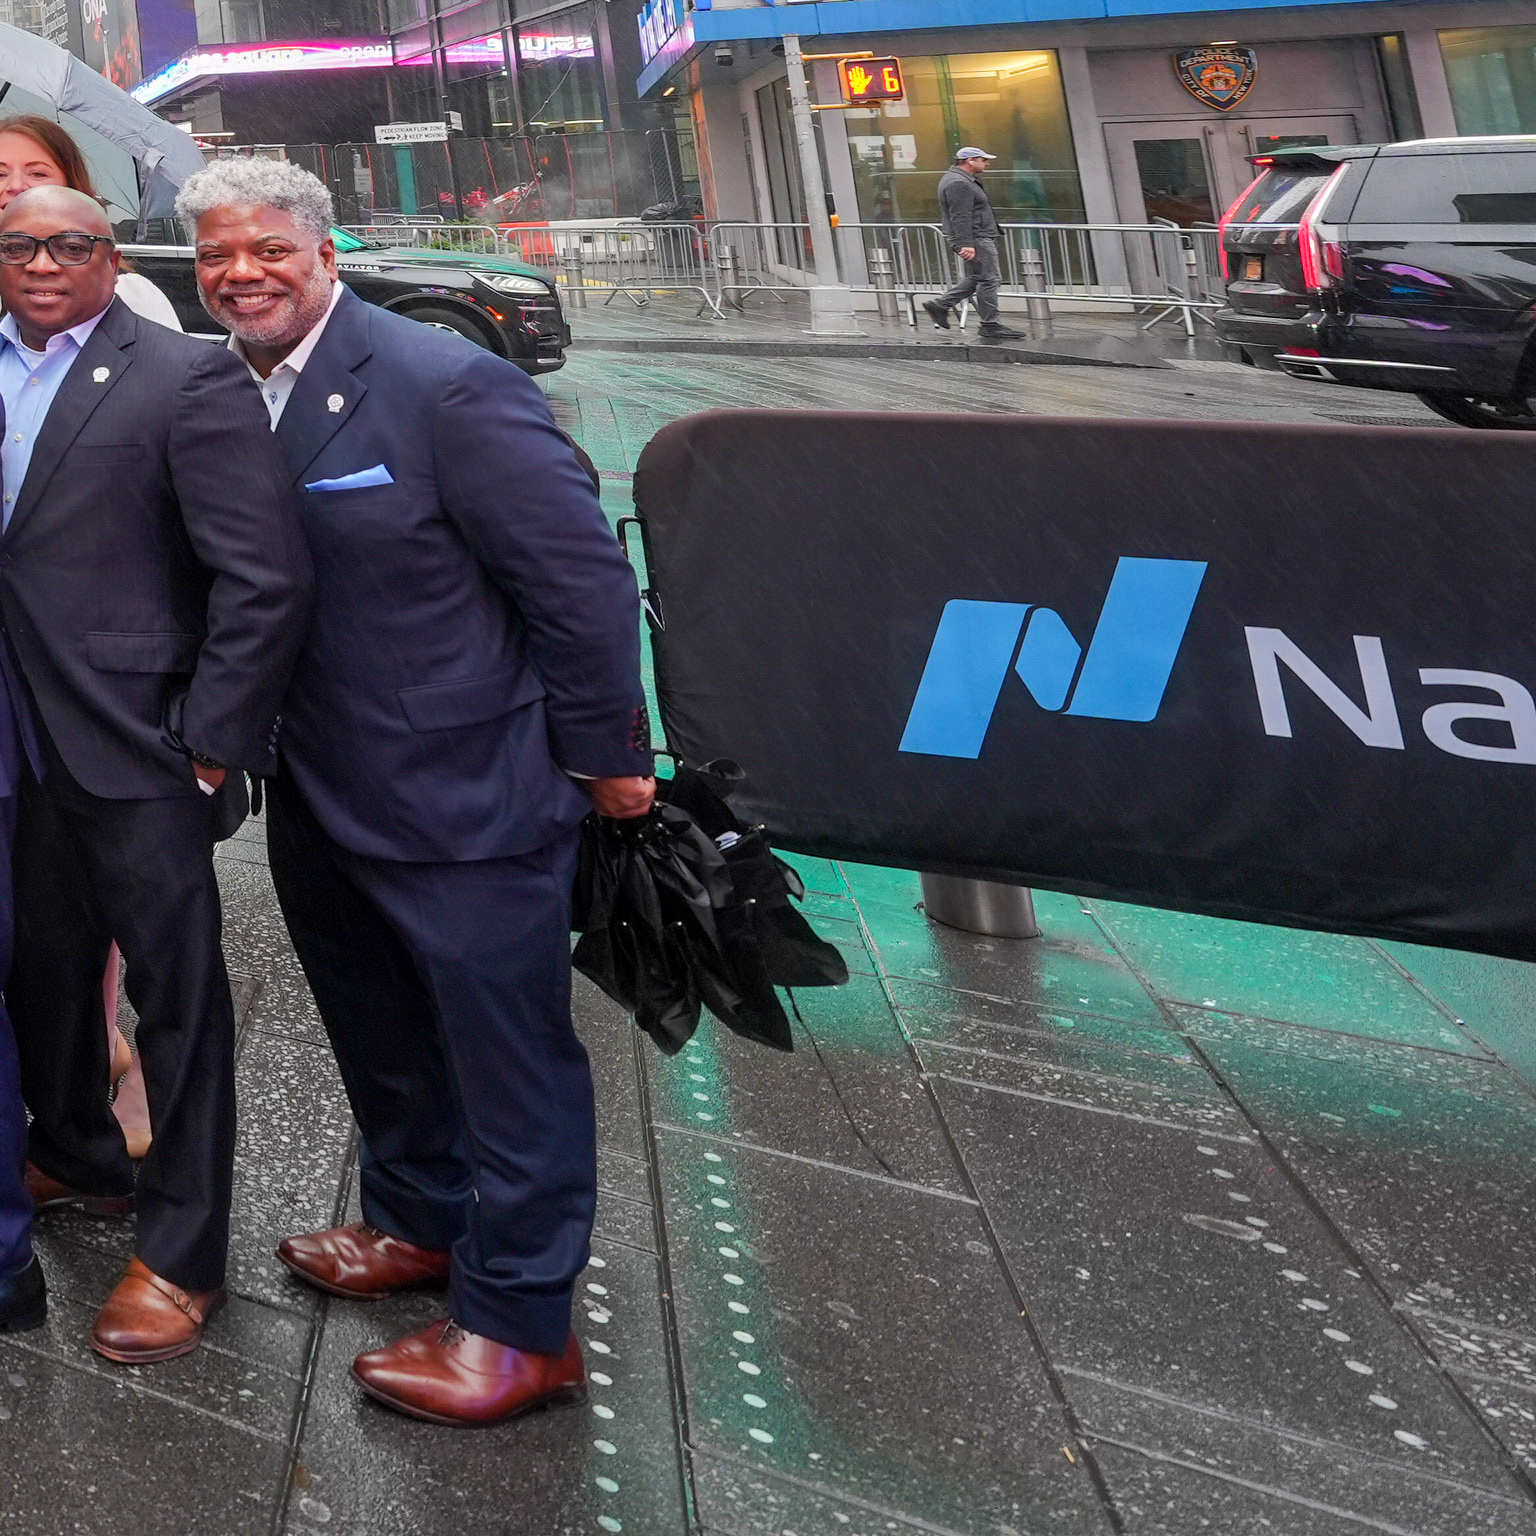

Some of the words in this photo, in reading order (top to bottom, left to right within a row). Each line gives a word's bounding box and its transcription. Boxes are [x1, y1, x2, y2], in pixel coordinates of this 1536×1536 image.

[1180, 54, 1250, 67] DEPARTMENT
[883, 66, 900, 93] 6
[381, 126, 413, 134] PEDESTRIAN
[426, 131, 445, 139] MOVING
